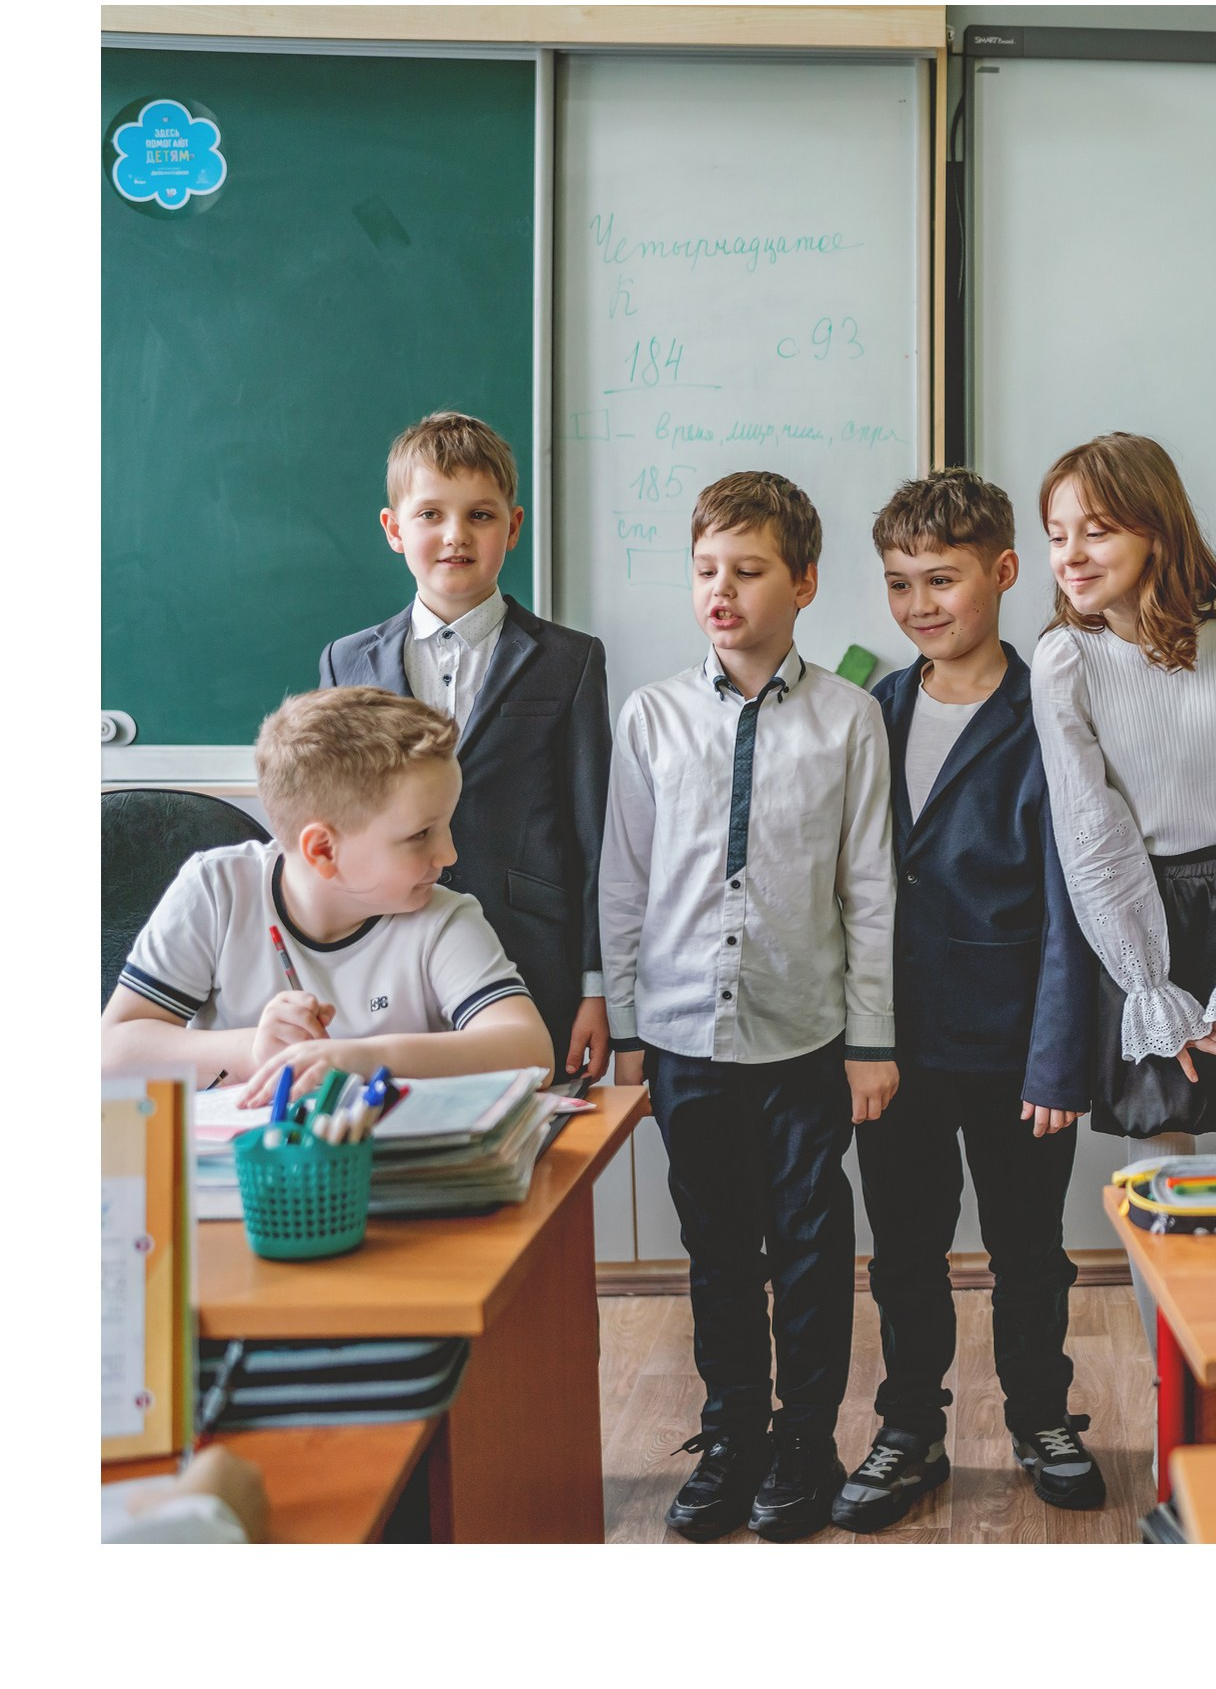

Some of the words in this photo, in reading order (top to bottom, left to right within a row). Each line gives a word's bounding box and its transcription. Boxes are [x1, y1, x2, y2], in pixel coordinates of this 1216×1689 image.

[145, 138, 189, 149] ПОМОГАЮТ
[154, 128, 180, 138] ЗДЕСЬ
[146, 149, 190, 164] ДЕТЯМ
[589, 211, 866, 273] Четырнадцатое
[624, 336, 684, 387] 184
[629, 464, 697, 502] 185
